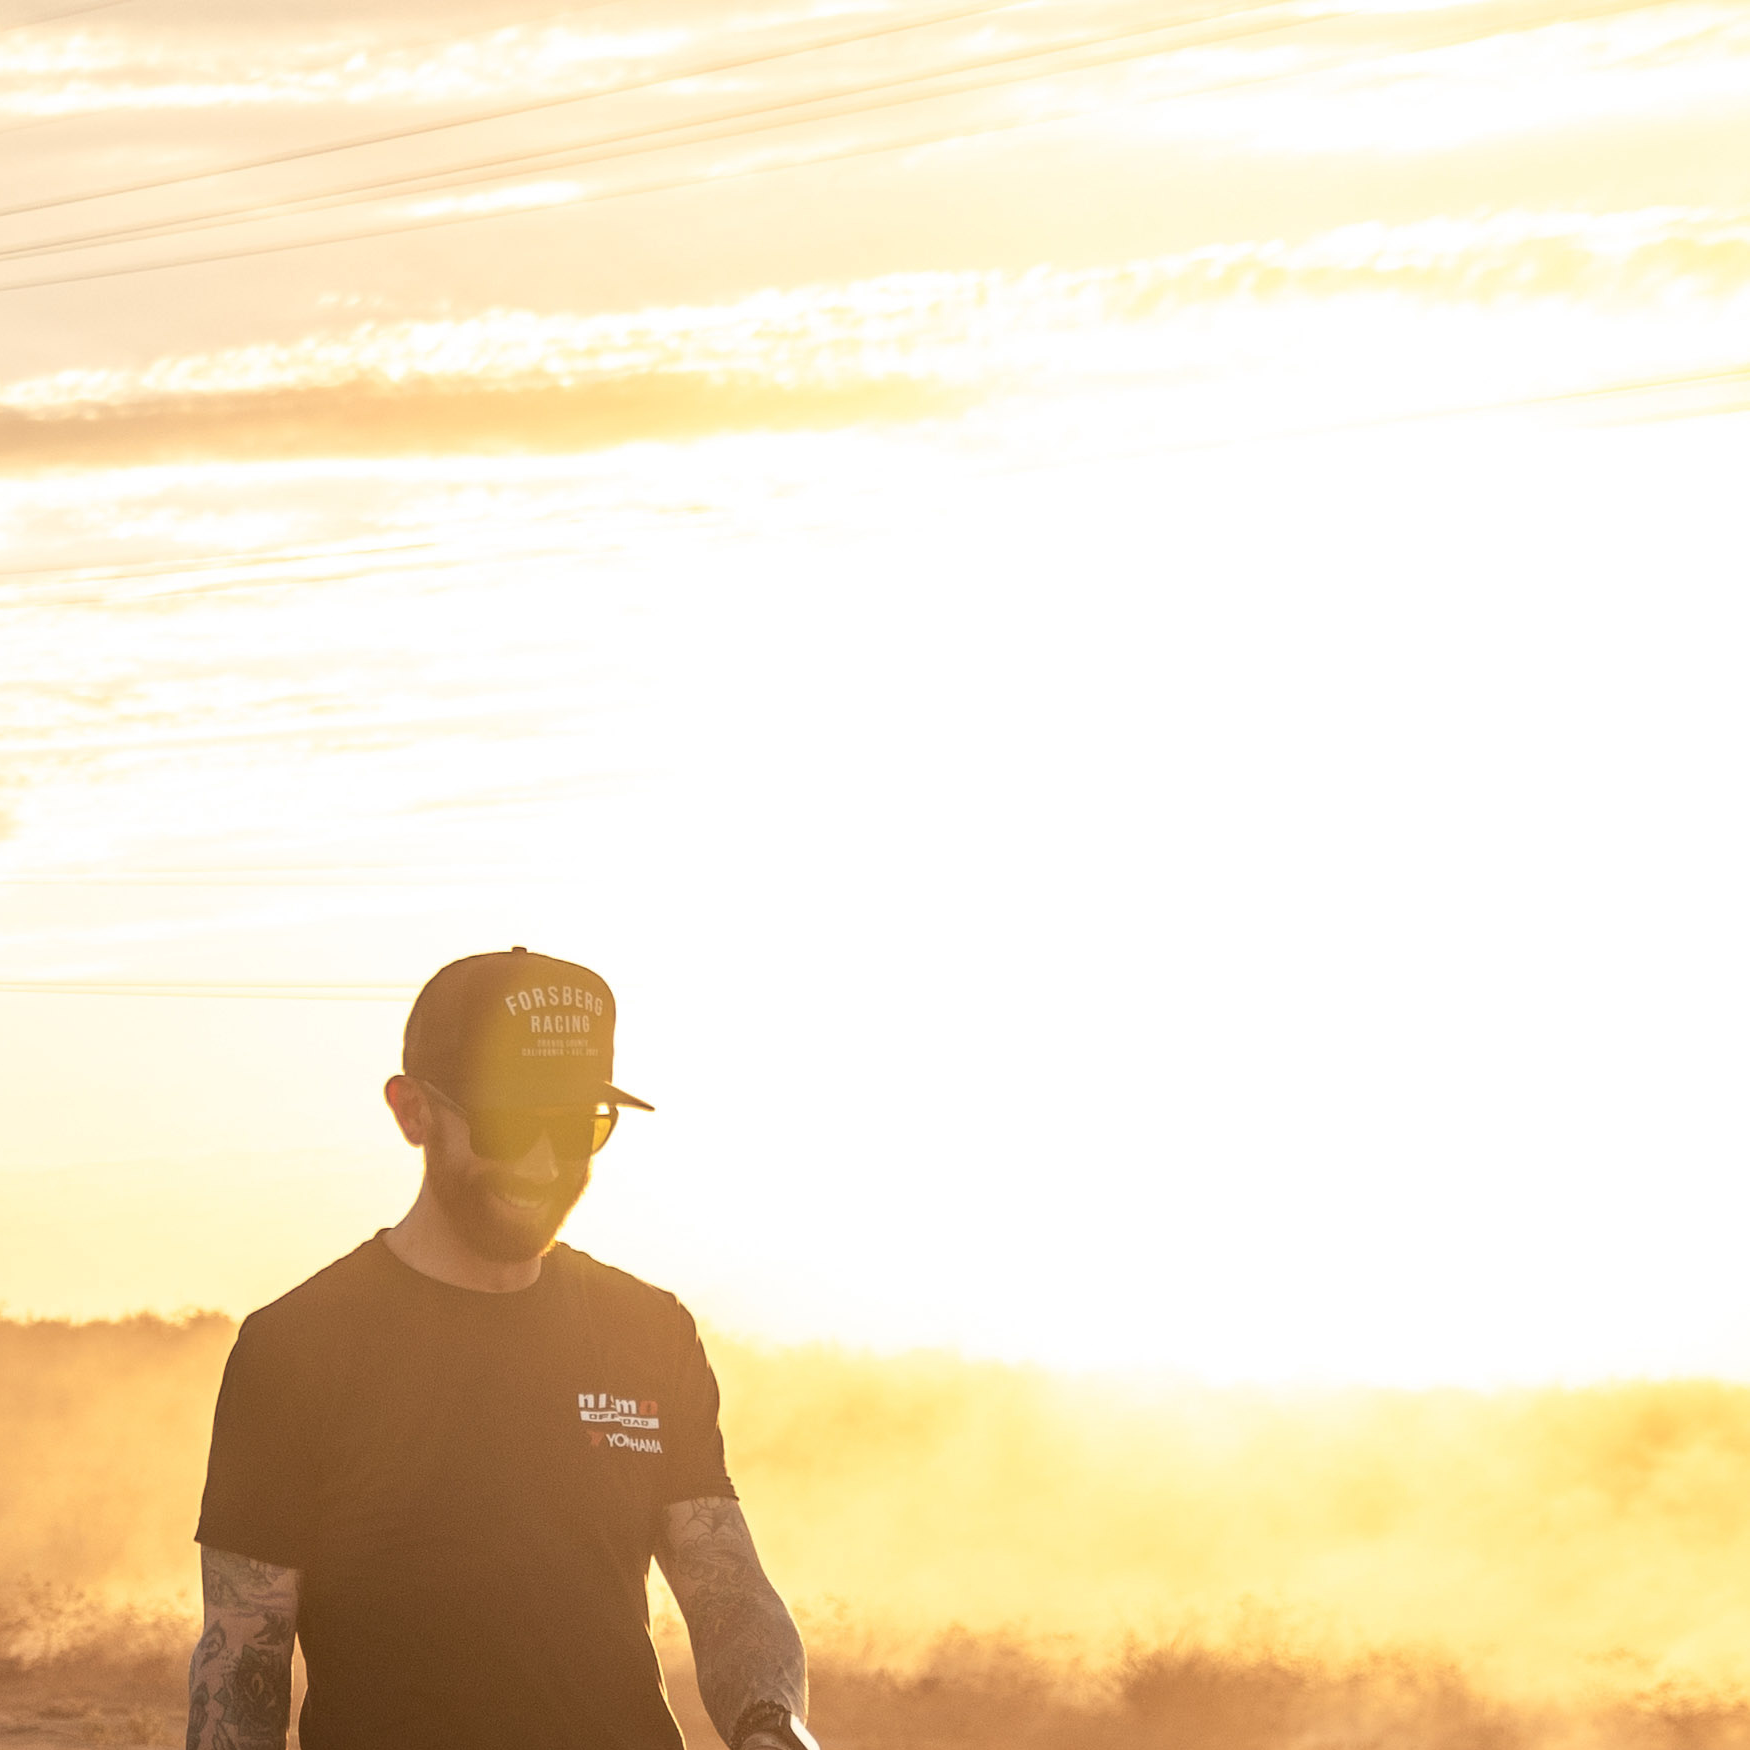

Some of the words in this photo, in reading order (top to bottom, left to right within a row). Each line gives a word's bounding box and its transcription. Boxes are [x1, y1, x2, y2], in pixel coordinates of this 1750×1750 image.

[505, 986, 603, 1016] FORSBERG
[531, 1015, 590, 1033] RACING
[605, 1432, 663, 1454] YOHAMA
